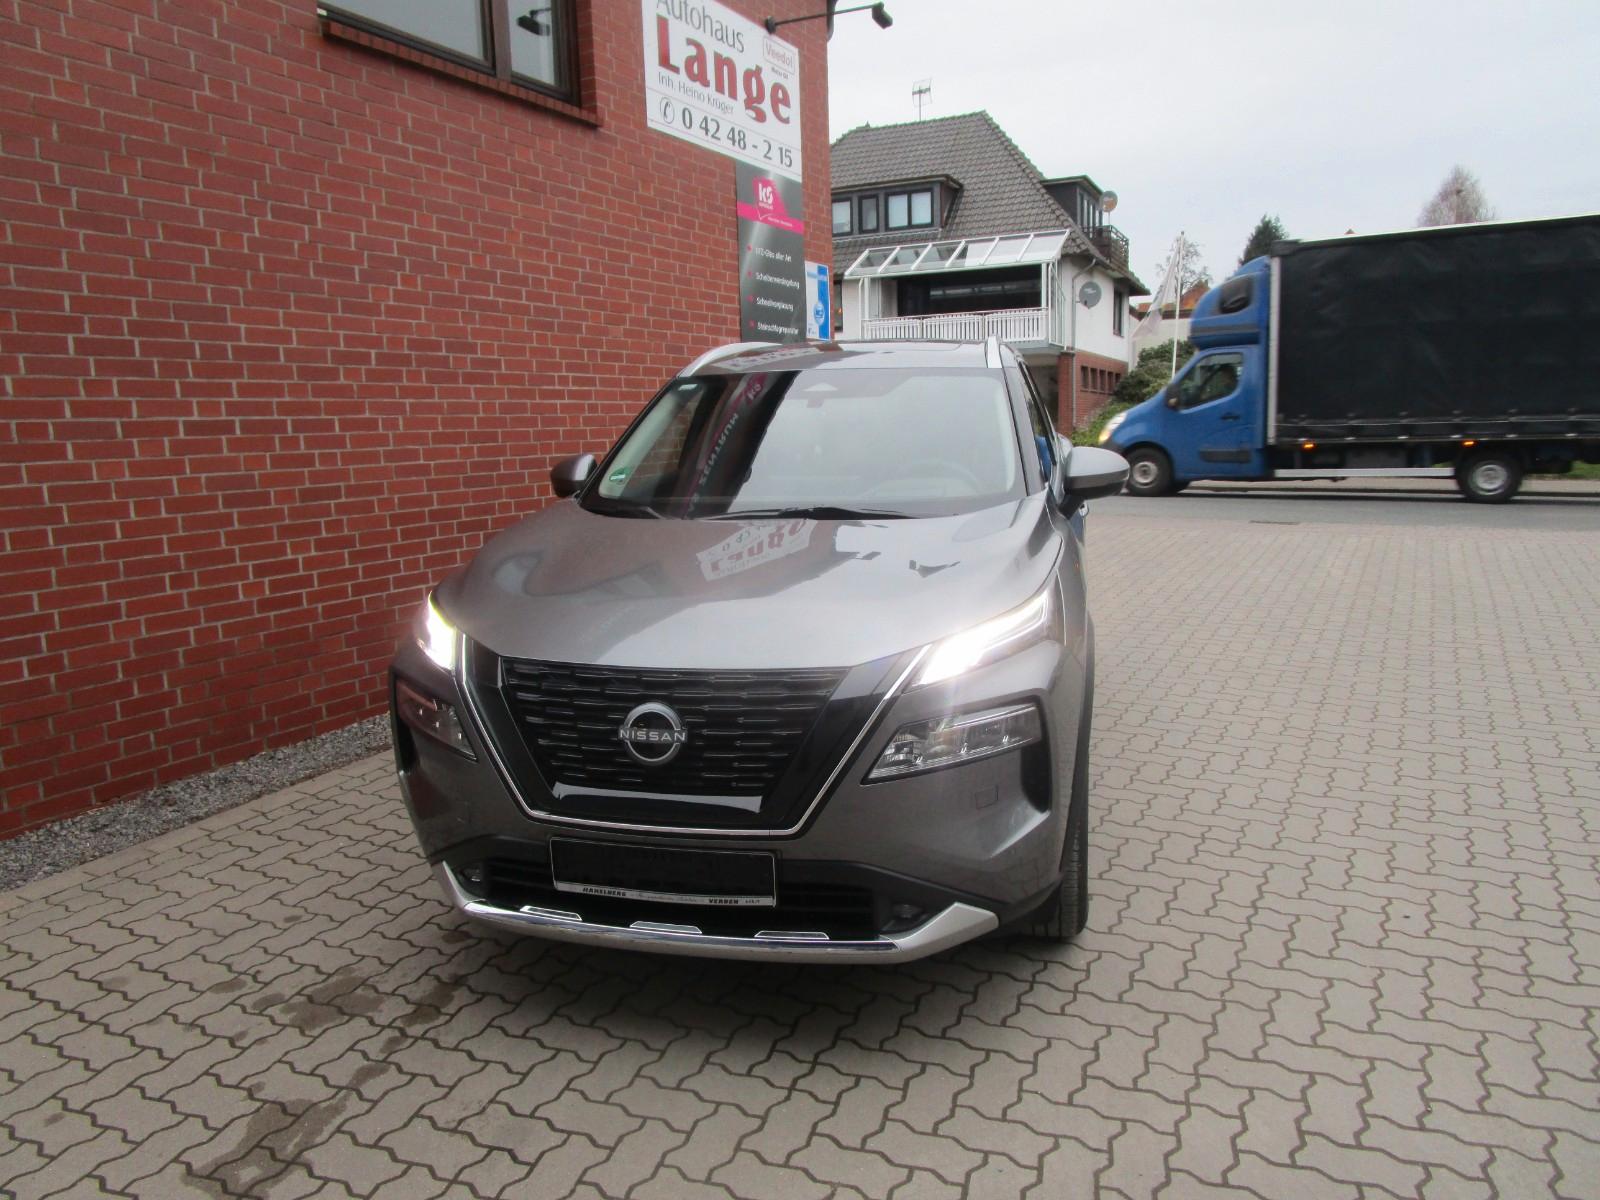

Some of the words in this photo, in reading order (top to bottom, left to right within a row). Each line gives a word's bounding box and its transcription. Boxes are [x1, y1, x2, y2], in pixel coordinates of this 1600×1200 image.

[656, 0, 745, 53] Autohaus
[657, 14, 791, 125] Lange
[658, 72, 677, 91] Inh.
[678, 80, 706, 102] Heino
[706, 96, 734, 115] Krüger
[682, 107, 692, 130] 0
[699, 115, 721, 141] 42
[726, 126, 747, 150] 48
[763, 139, 772, 160] 2
[778, 146, 793, 168] 15
[619, 729, 686, 741] NISSAN
